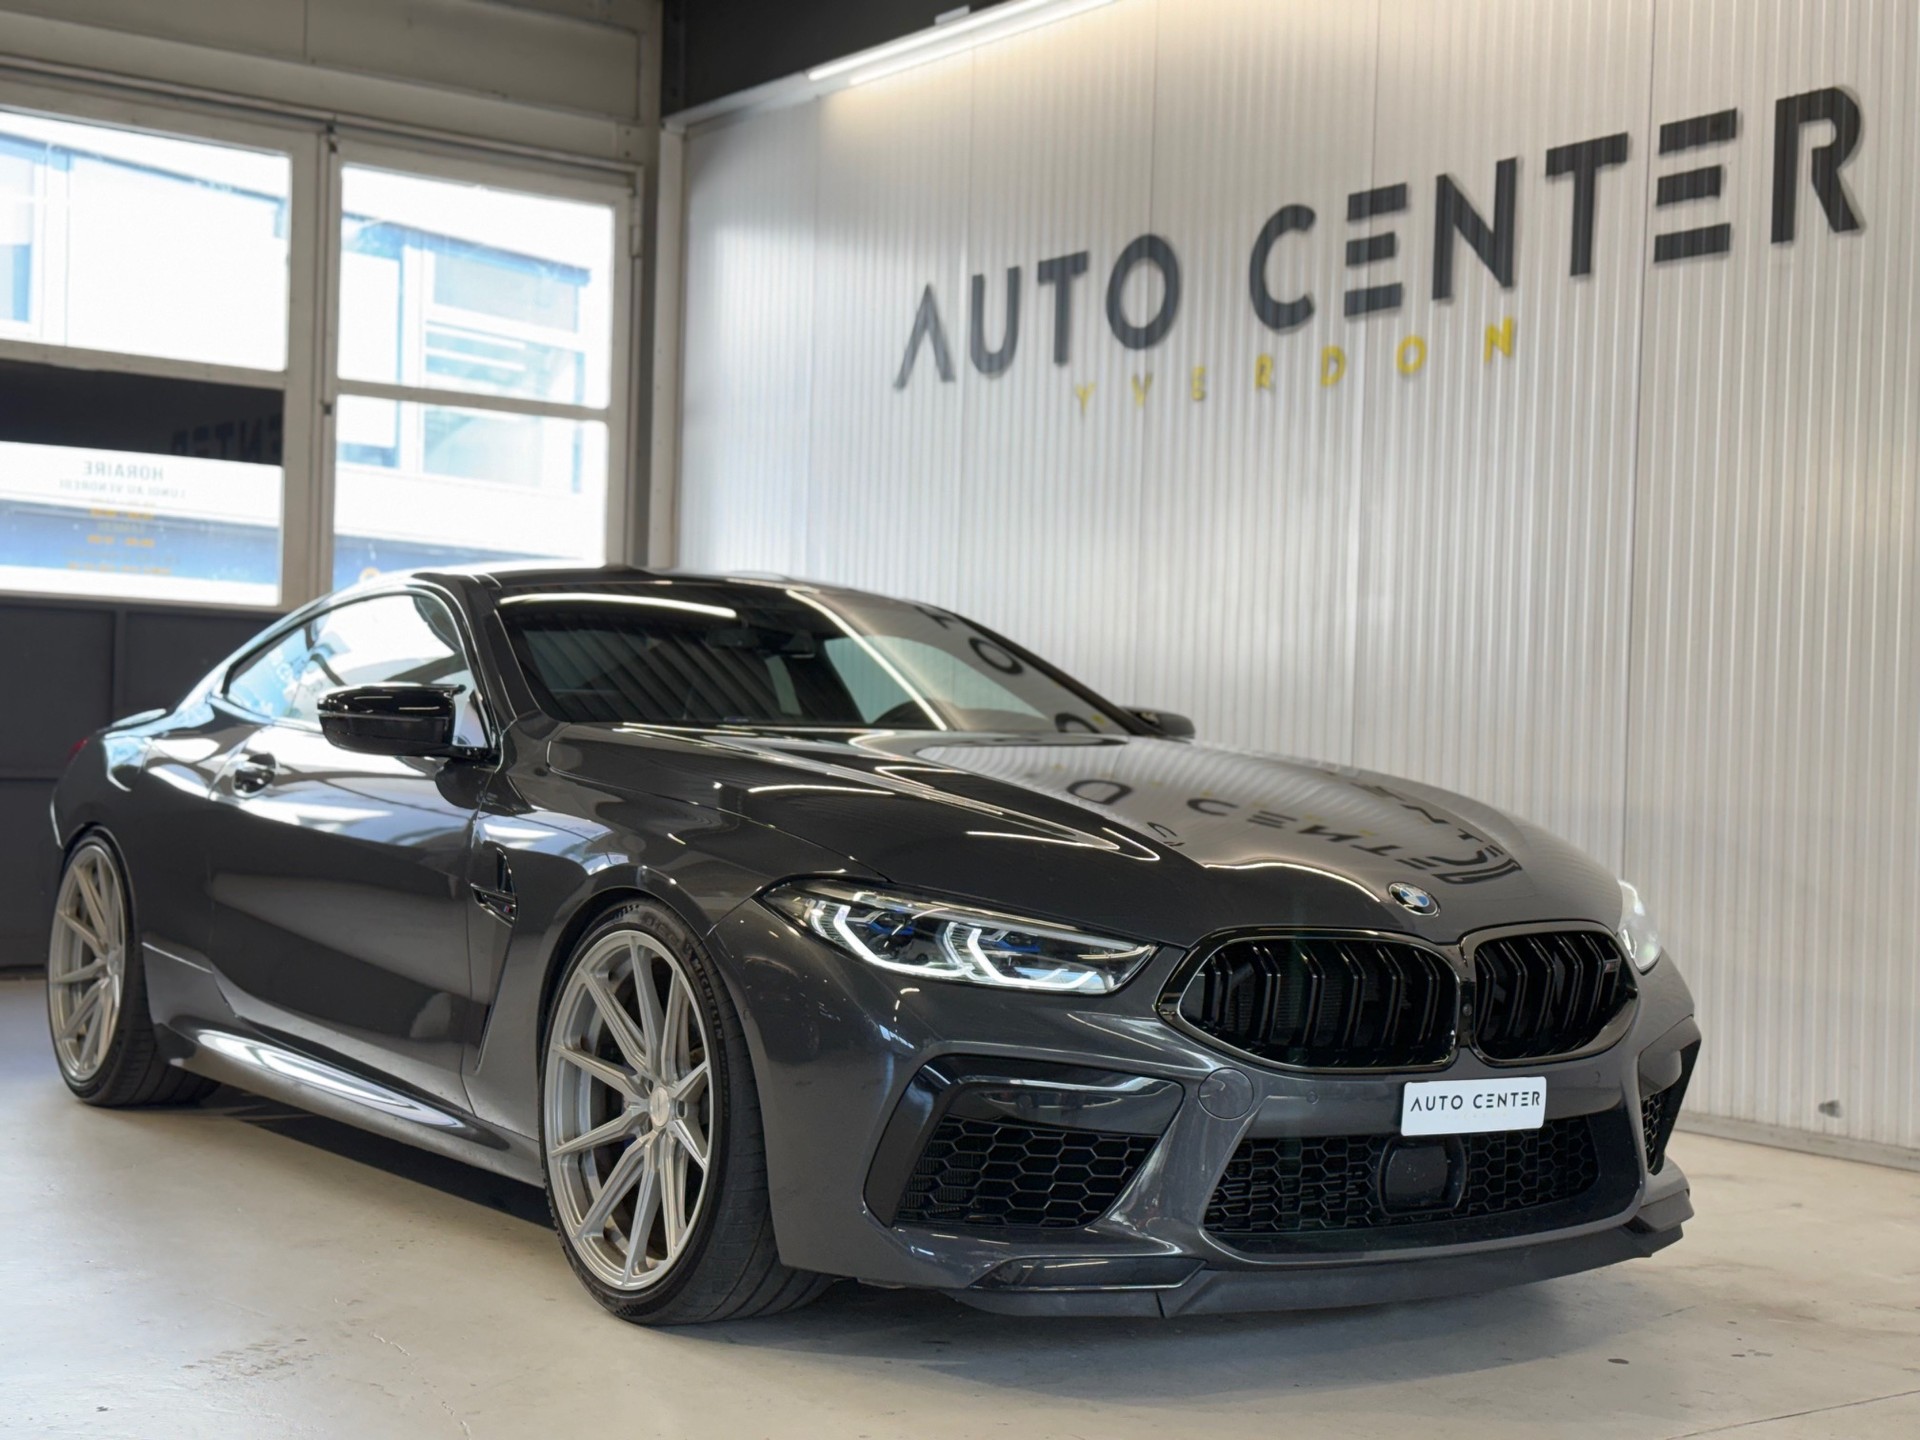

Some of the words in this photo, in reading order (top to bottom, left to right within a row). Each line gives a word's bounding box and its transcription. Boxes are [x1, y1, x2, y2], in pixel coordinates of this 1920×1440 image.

[893, 234, 1180, 390] AUTO
[1250, 86, 1862, 330] CENTER
[1074, 316, 1516, 415] YVERDON
[690, 958, 725, 1040] MICHELIN
[1410, 1094, 1464, 1112] AUTO
[1473, 1091, 1541, 1109] CENTER
